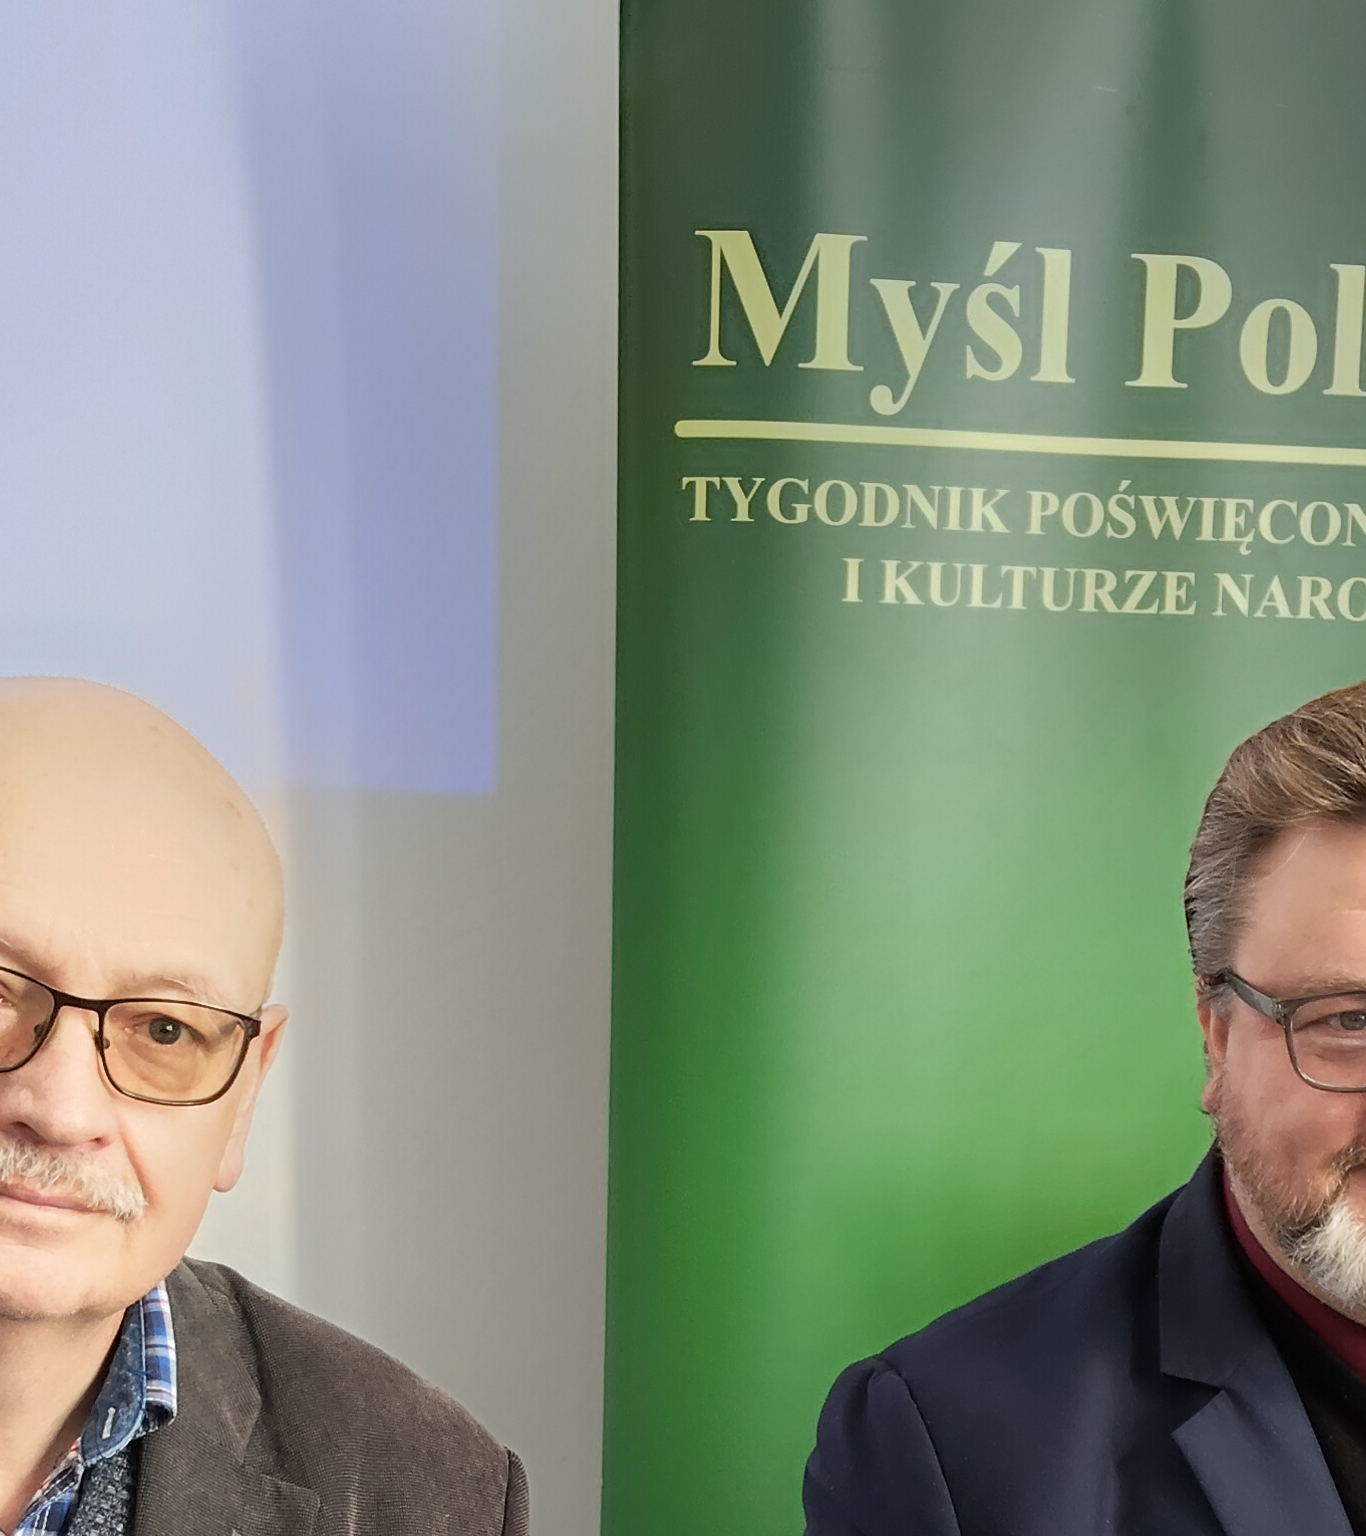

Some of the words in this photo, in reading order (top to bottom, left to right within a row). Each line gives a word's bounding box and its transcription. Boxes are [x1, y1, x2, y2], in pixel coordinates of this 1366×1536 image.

[691, 229, 1076, 415] Myśl
[682, 476, 1011, 534] TYGODNIK
[842, 558, 864, 604] I
[878, 560, 1197, 617] KULTURZE
